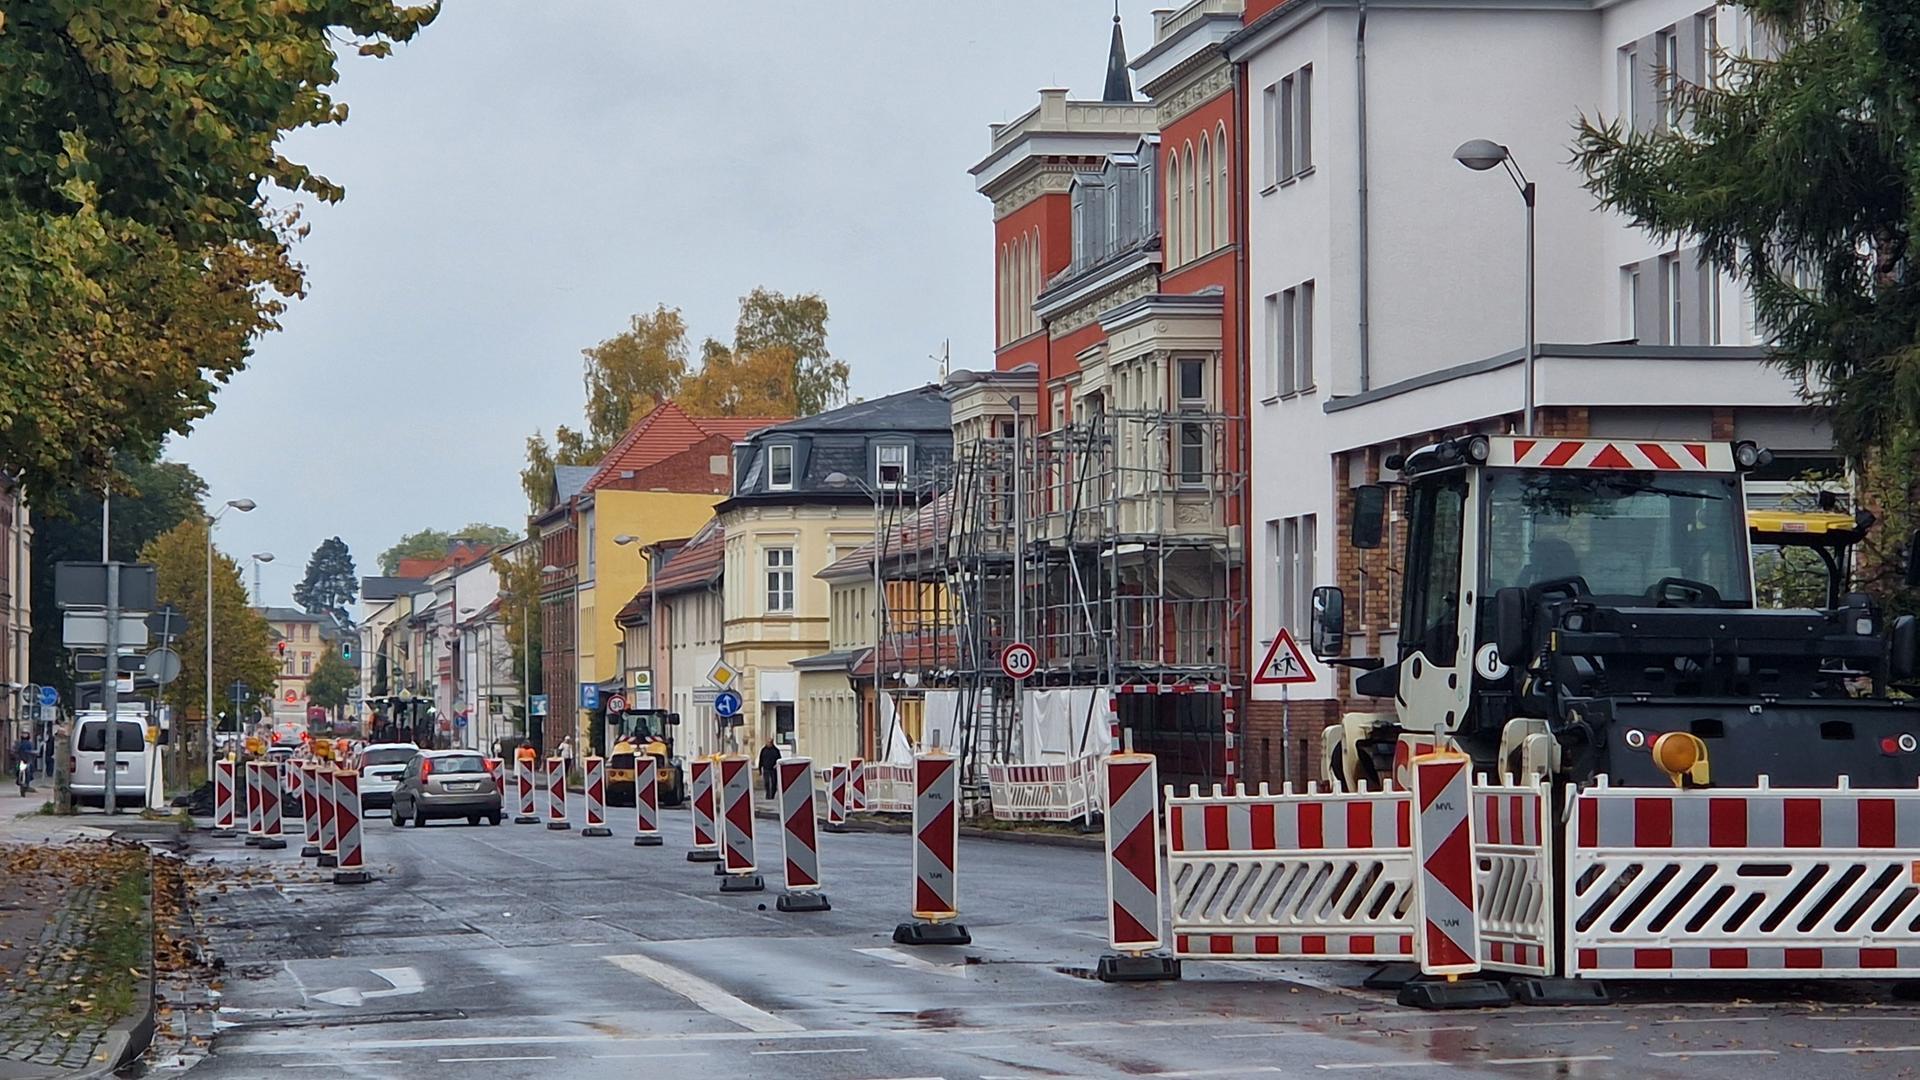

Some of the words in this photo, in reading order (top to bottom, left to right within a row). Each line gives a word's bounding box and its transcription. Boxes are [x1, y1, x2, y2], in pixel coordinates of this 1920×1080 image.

[1009, 653, 1029, 668] 30
[1488, 650, 1498, 673] 8
[612, 700, 623, 709] 30
[1436, 803, 1454, 811] MVL
[1442, 919, 1459, 927] MVL
